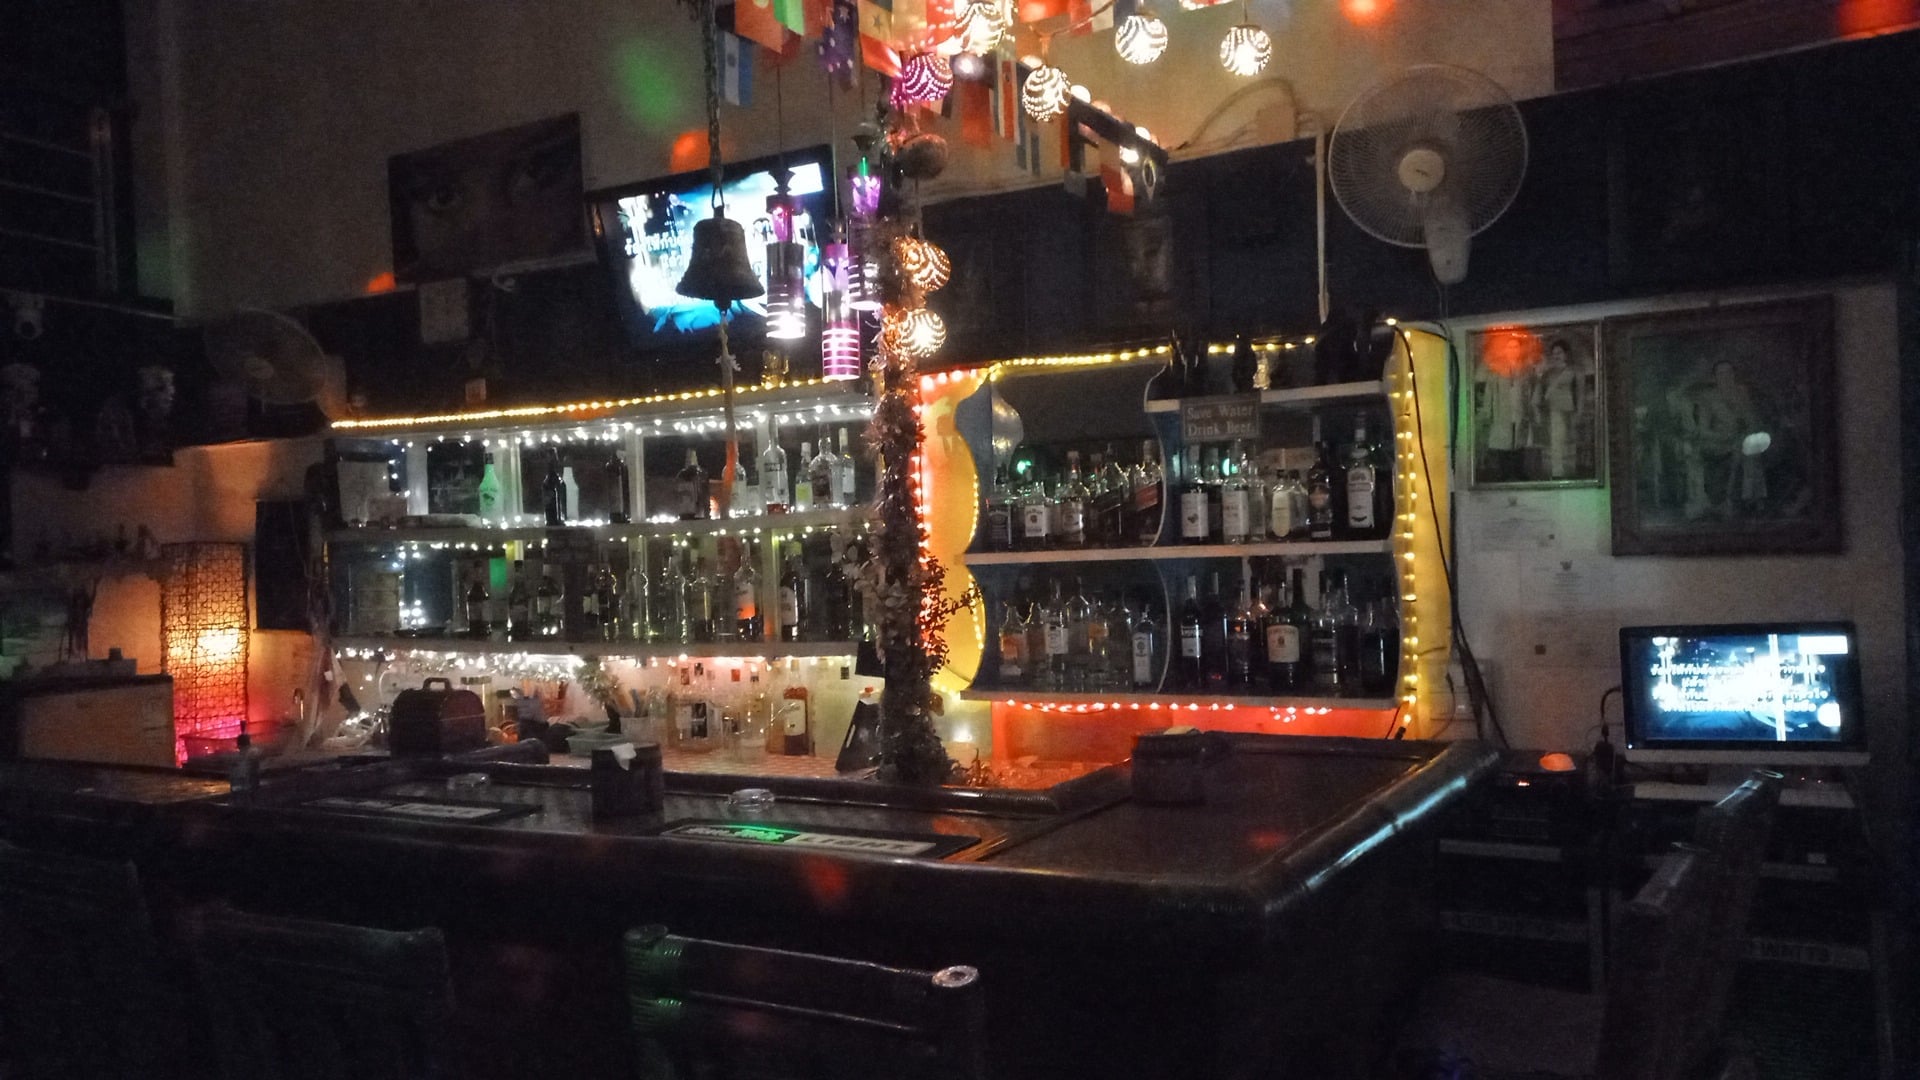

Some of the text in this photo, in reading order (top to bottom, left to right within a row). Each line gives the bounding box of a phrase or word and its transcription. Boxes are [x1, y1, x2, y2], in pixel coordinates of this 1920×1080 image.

[1187, 404, 1253, 419] Save Water
[1187, 422, 1220, 436] Drink
